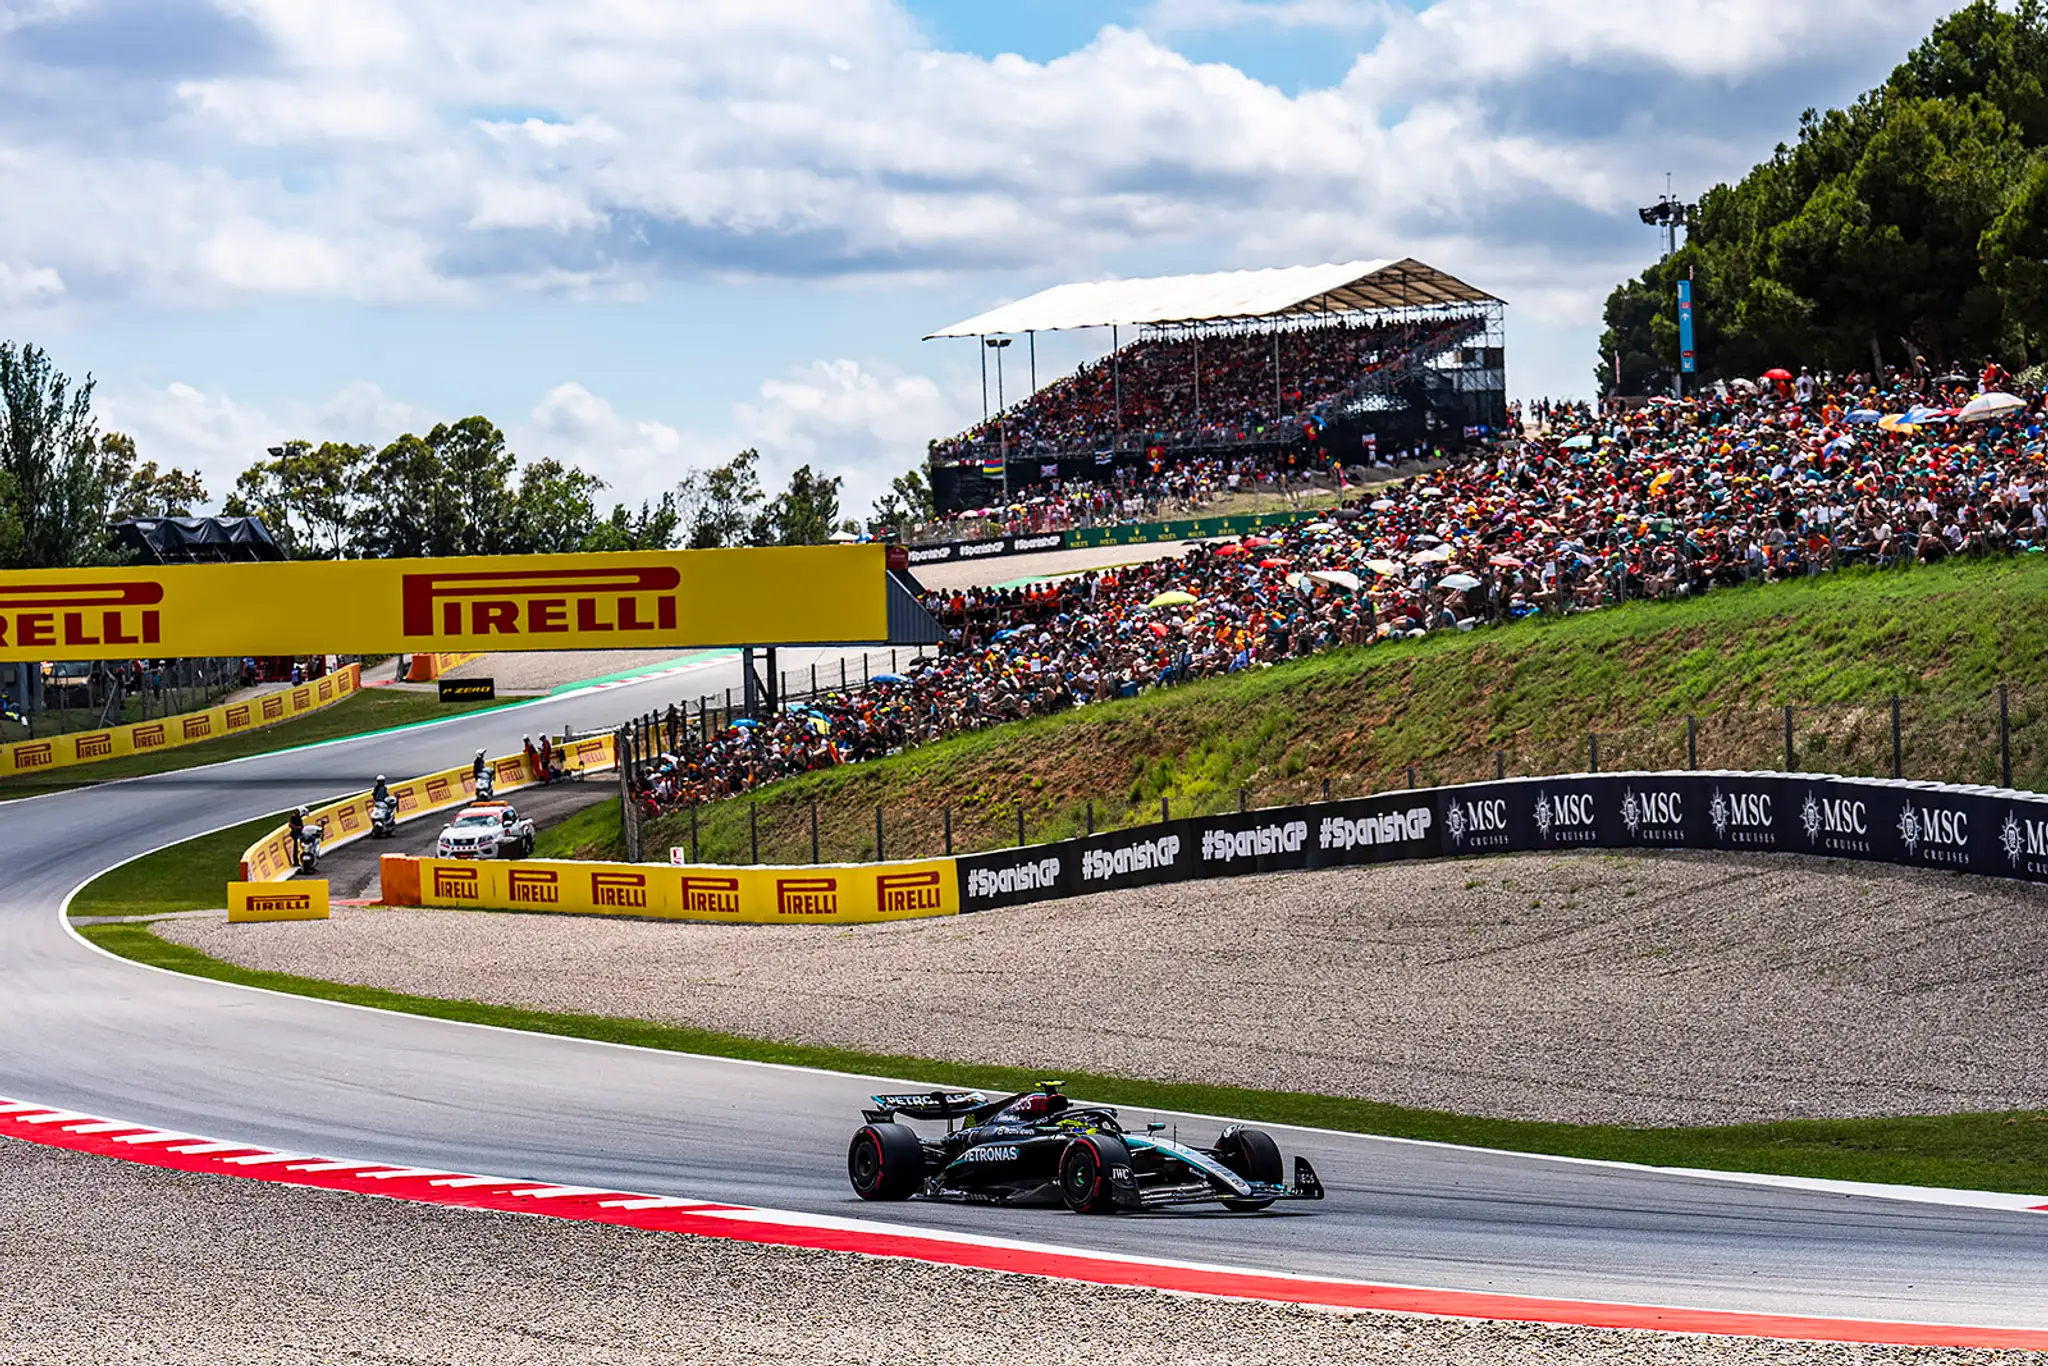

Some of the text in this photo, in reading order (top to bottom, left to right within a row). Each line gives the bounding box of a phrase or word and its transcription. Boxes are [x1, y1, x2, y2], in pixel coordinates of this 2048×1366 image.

[402, 566, 680, 636] PIRELLI
[454, 686, 491, 694] ZERO
[226, 705, 250, 729] PIRELLI
[263, 696, 283, 720] PIRELLI
[132, 724, 165, 748] PIRELLI
[183, 715, 211, 740] PIRELLI
[14, 743, 52, 769] PIRELLI
[76, 733, 112, 759] PIRELLI
[497, 760, 525, 784] PIRELLI
[425, 778, 452, 804] PIRELLI
[1466, 799, 1507, 831] MSC
[1554, 794, 1595, 826] MSC
[1641, 792, 1683, 824] MSC
[1729, 793, 1773, 826] MSC
[1822, 799, 1867, 835] MSC
[1319, 807, 1432, 850] #SpanishGP
[1555, 830, 1596, 842] CRUISES
[1643, 828, 1685, 840] CRUISES
[1732, 832, 1776, 844] CRUISES
[1922, 808, 1968, 846] MSC
[1201, 820, 1308, 862] #SpanishGP
[1470, 835, 1509, 847] CRUISES
[1825, 838, 1870, 852] CRUISES
[1082, 835, 1180, 880] #SpanishGP
[1923, 849, 1970, 864] CRUISES
[434, 867, 478, 899] PIRELLI
[509, 869, 558, 903] PIRELLI
[591, 872, 647, 908] PIRELLI
[968, 857, 1060, 898] #SpanishGP
[246, 895, 310, 911] PIRELLI
[681, 876, 739, 913] PIRELLI
[777, 878, 837, 914] PIRELLI
[877, 871, 940, 912] PIRELLI
[886, 1095, 964, 1105] PETROAS
[1113, 1168, 1129, 1180] IWC
